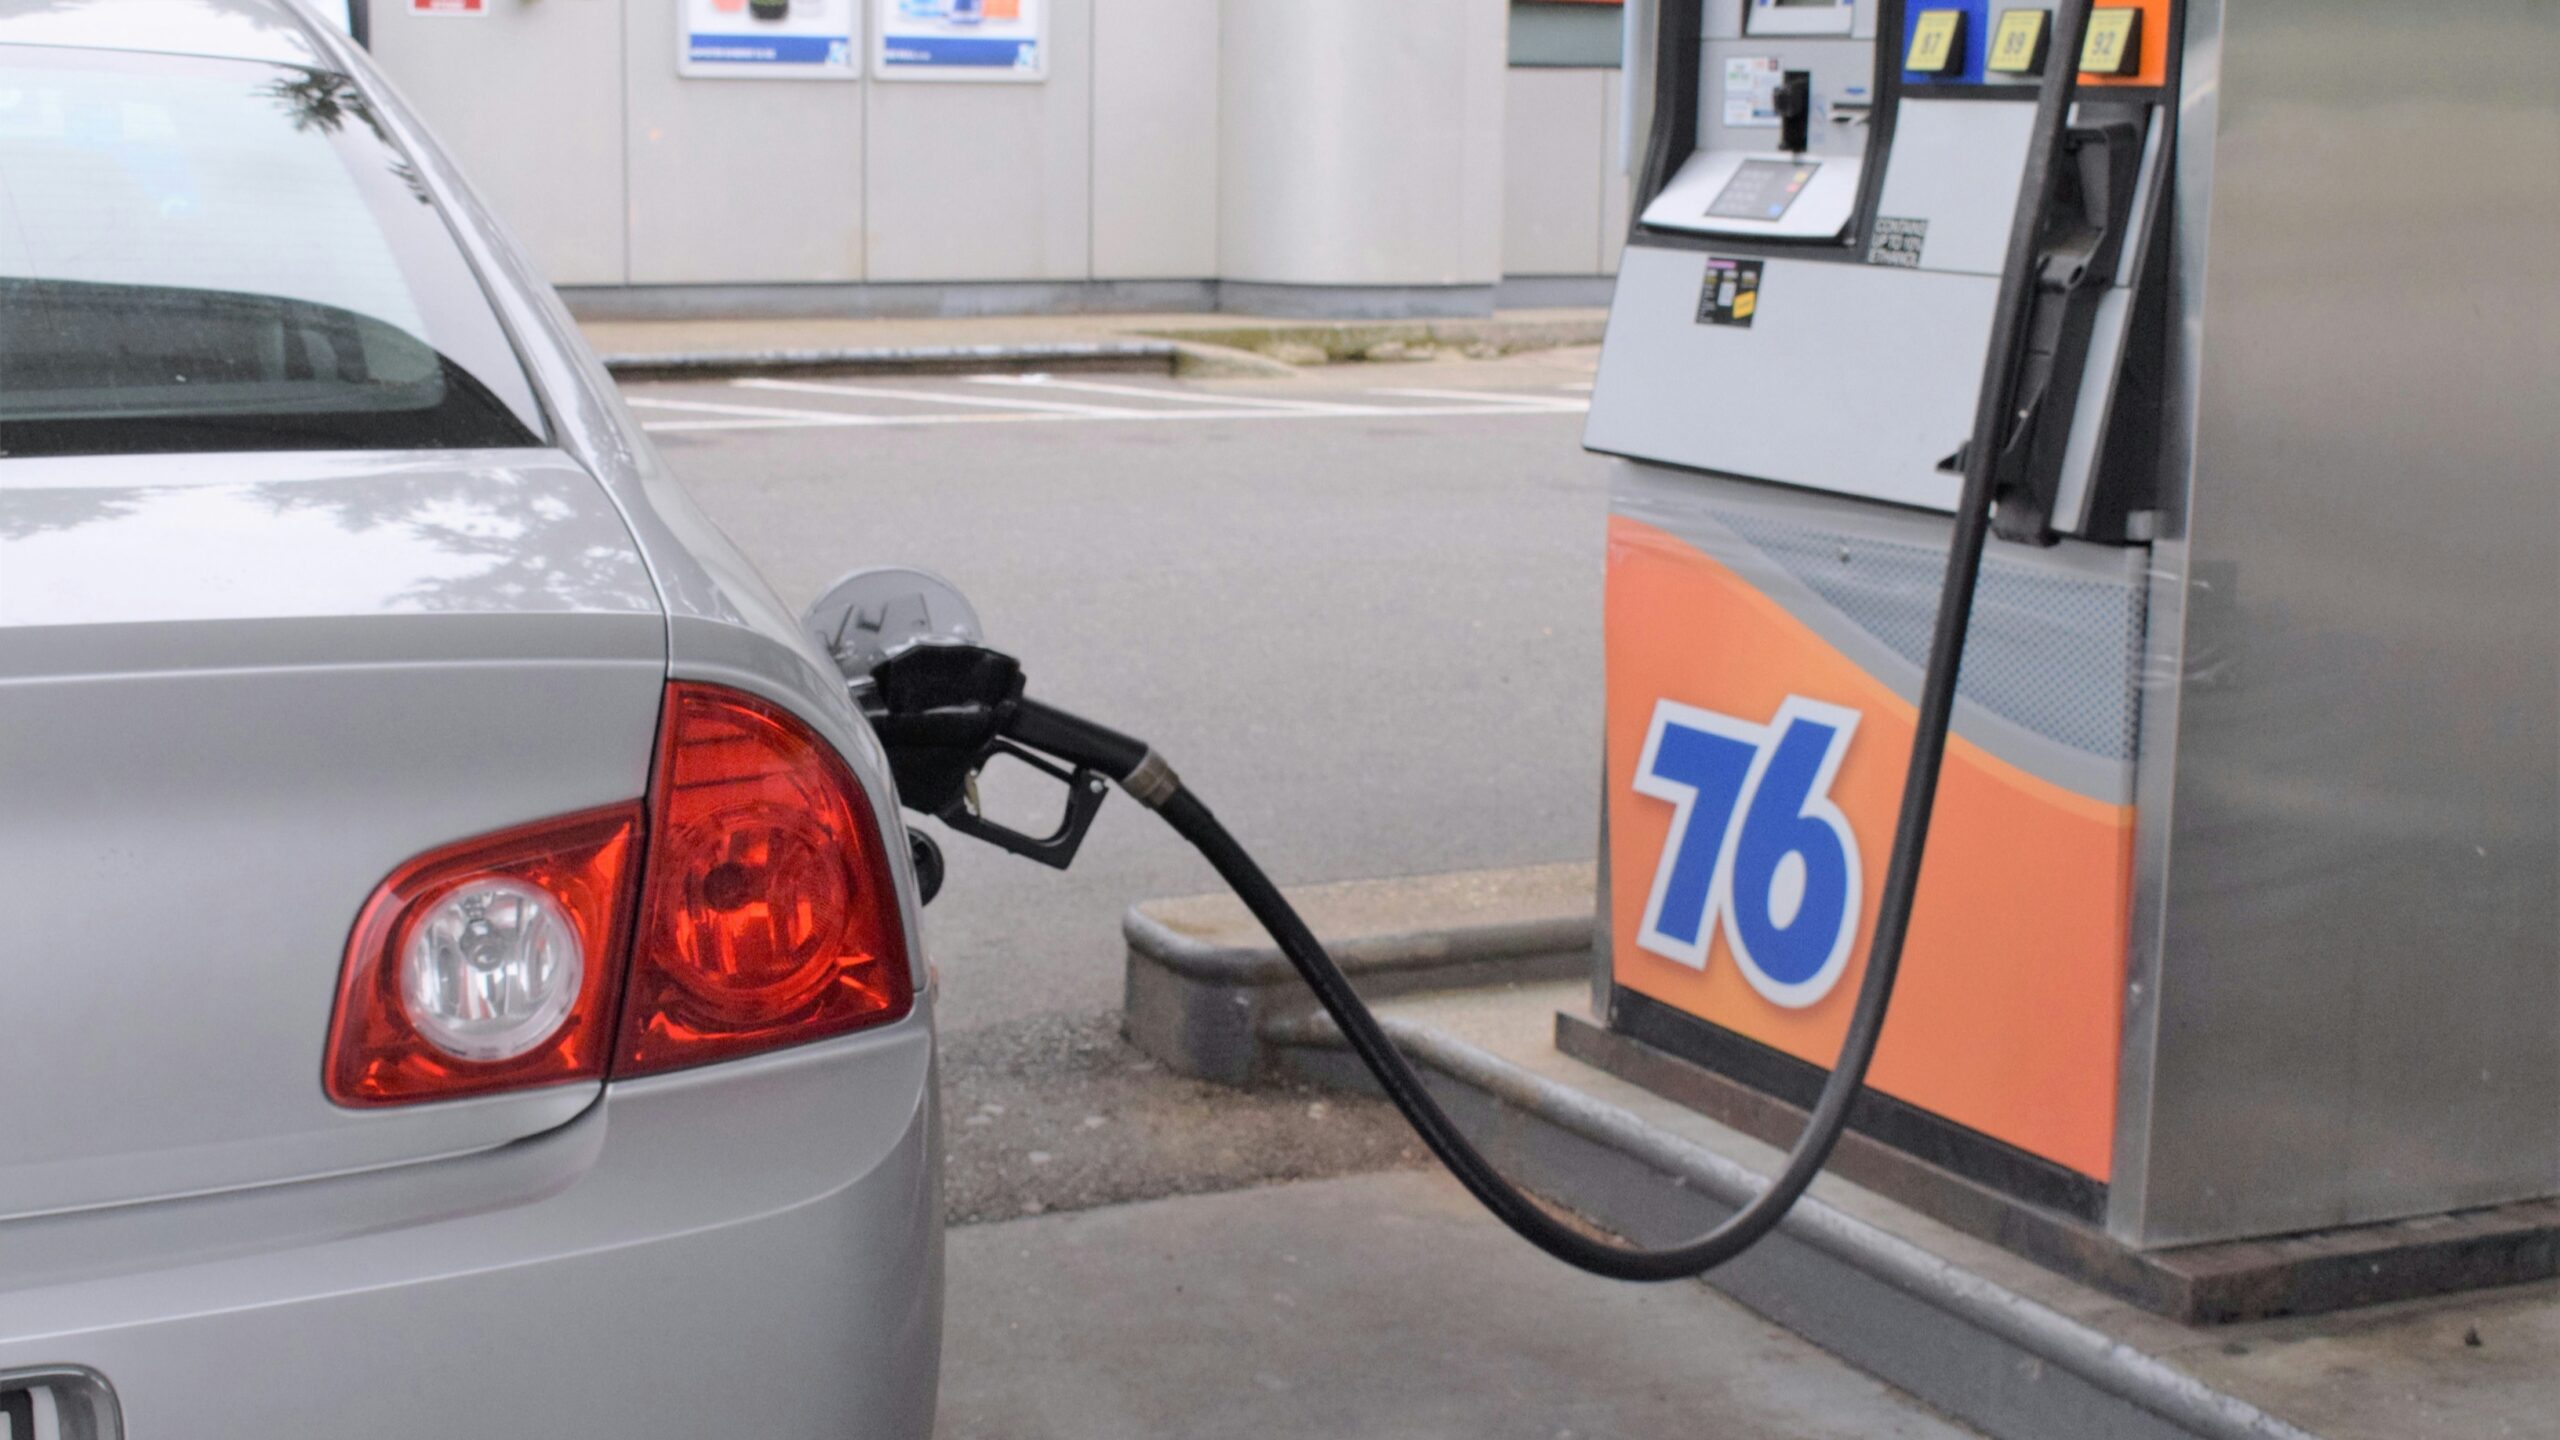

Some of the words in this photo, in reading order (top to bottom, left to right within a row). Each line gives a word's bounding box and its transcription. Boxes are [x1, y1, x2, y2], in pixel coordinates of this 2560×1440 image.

[1920, 32, 1942, 55] 87
[2002, 31, 2026, 54] 89
[2091, 31, 2115, 55] 92
[1868, 248, 1918, 267] ETHANOL
[1634, 695, 1861, 1006] 76
